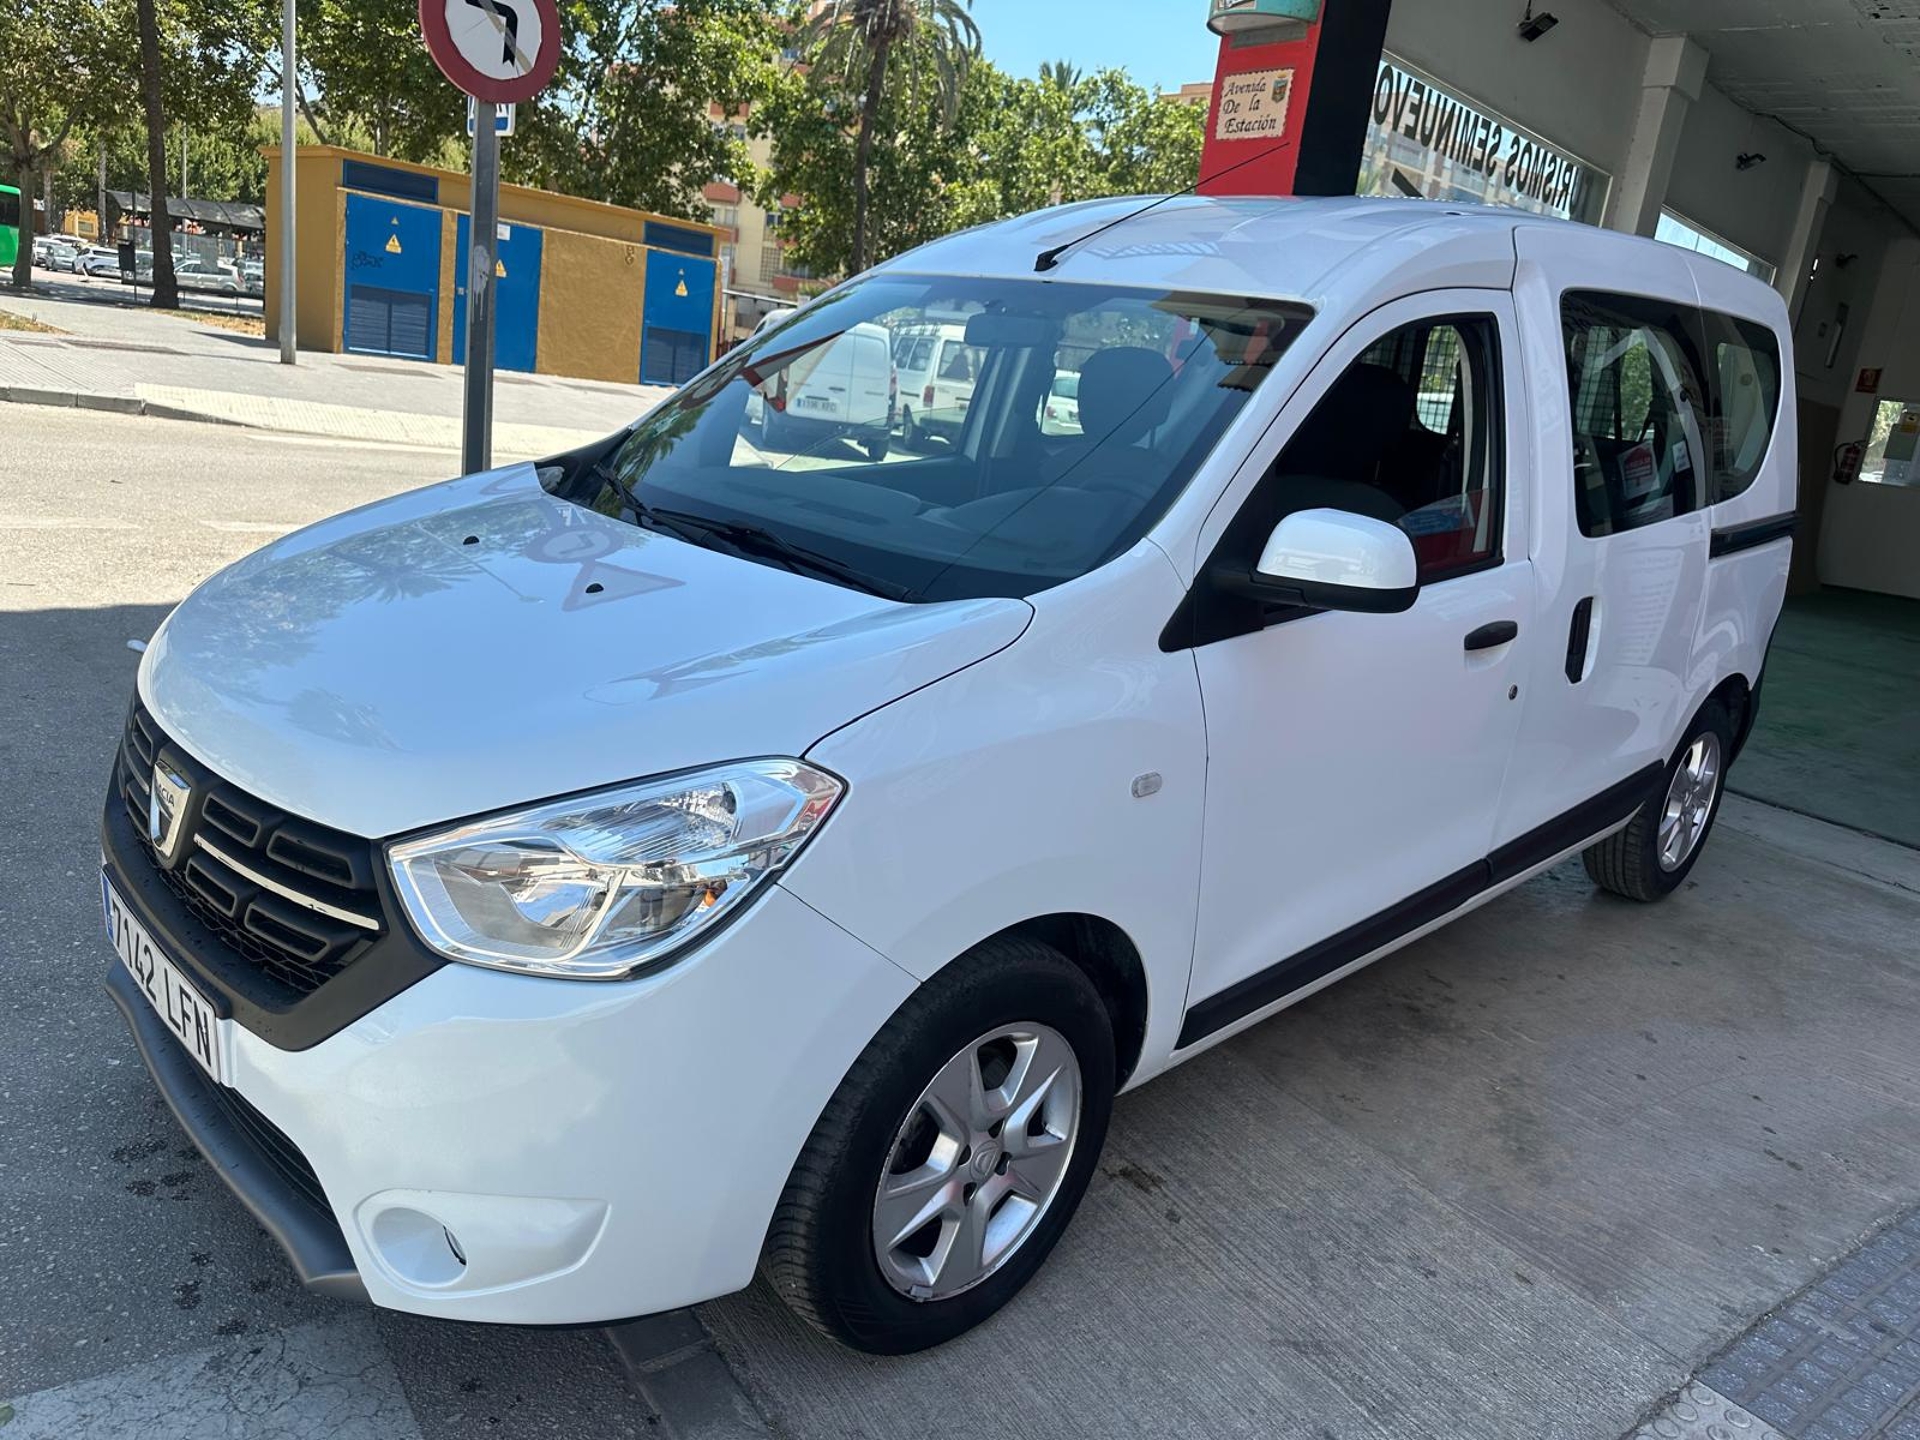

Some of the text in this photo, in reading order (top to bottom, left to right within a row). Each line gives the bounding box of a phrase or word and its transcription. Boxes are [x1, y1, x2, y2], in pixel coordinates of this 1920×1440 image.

[1224, 77, 1266, 97] Avenida
[1223, 93, 1260, 114] De la
[1225, 114, 1277, 134] Estación
[112, 898, 212, 1067] 7142 LFN
